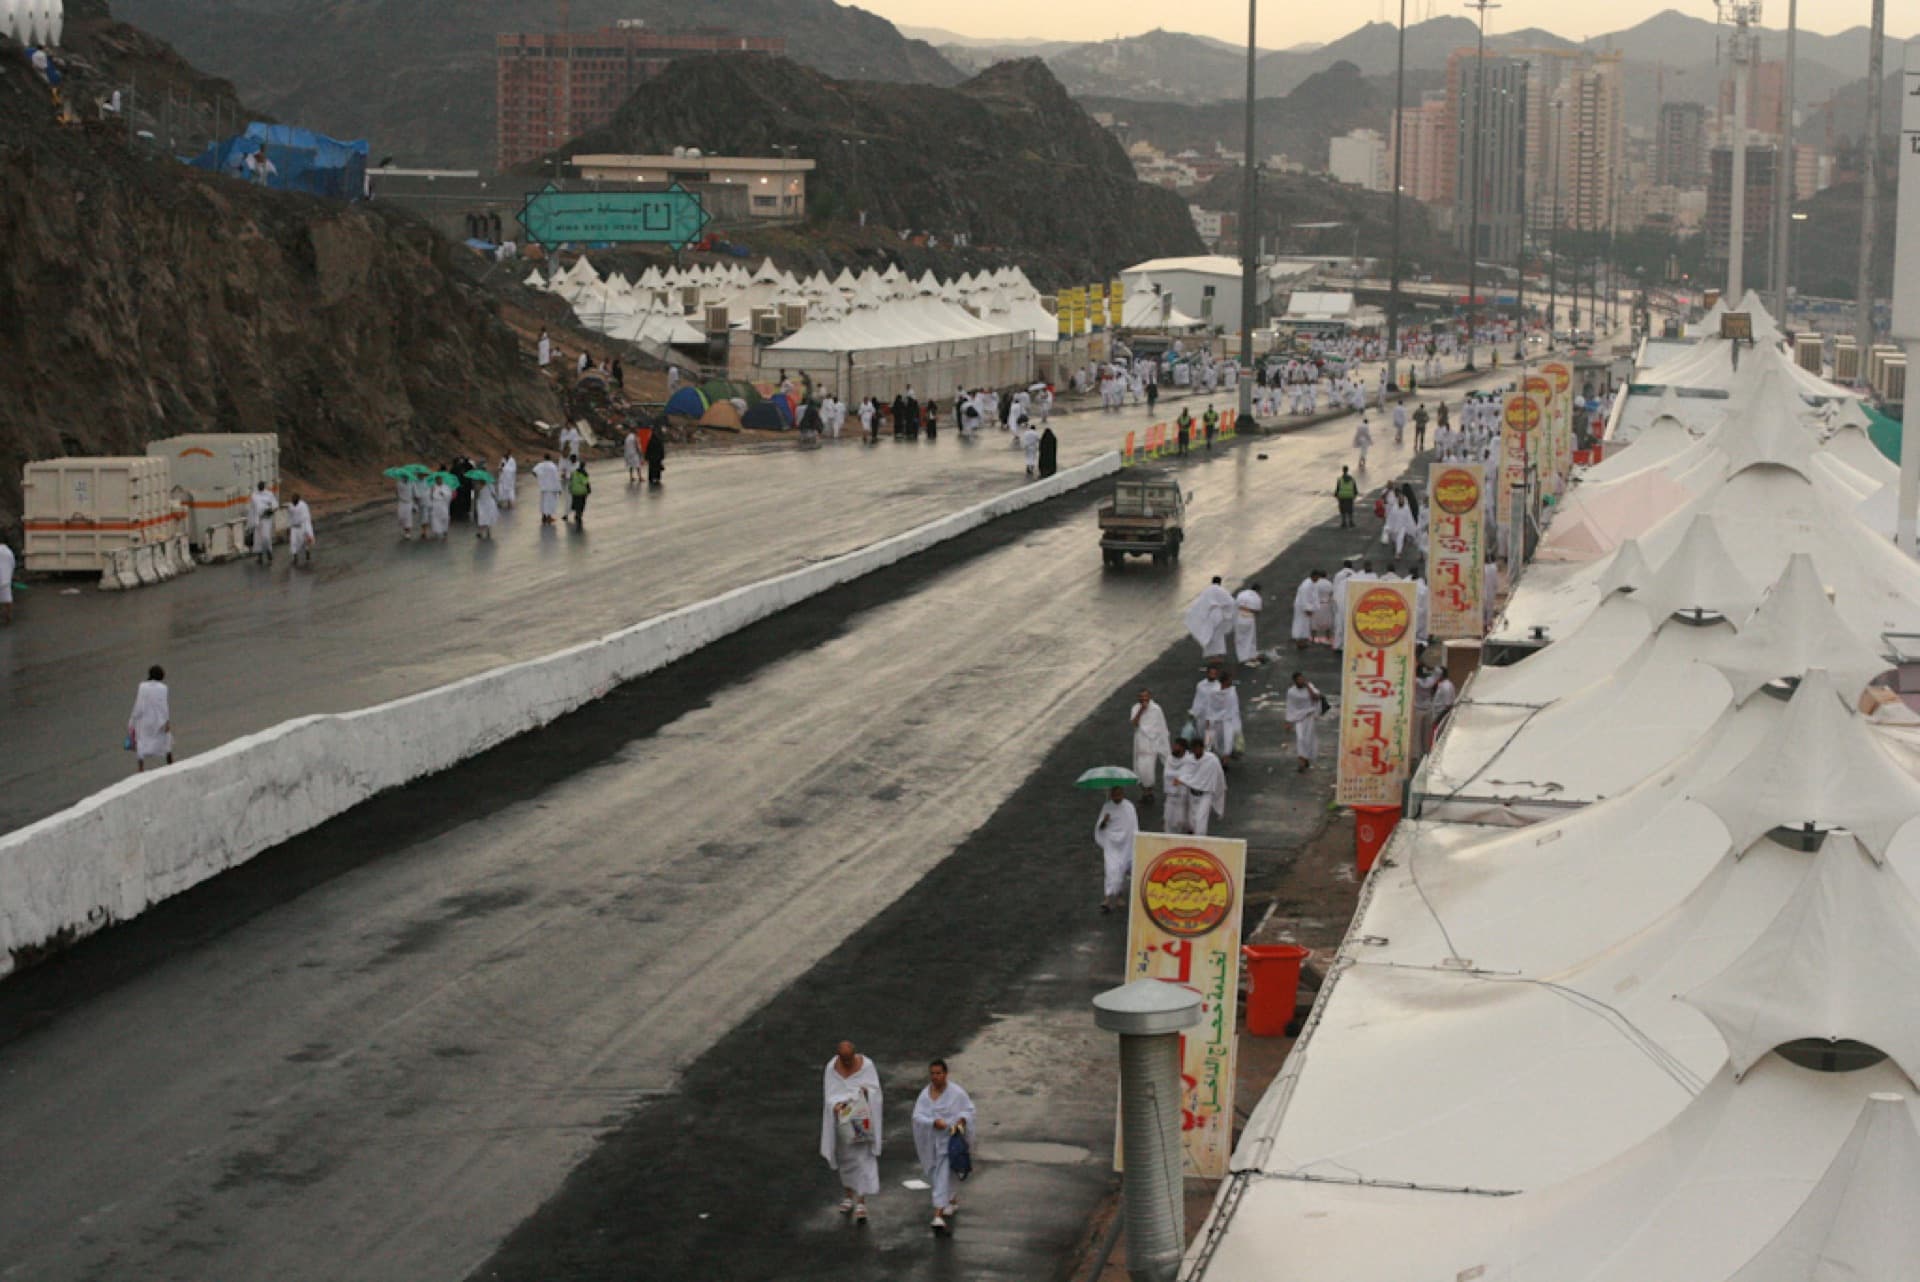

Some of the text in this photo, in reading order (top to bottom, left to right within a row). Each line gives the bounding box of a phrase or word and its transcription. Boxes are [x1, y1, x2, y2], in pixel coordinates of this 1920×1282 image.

[1355, 649, 1395, 699] غازي
[1350, 704, 1394, 775] القرشي
[1206, 950, 1227, 1000] لخدمة
[1206, 1003, 1227, 1055] حجاج
[1202, 1057, 1221, 1112] الداخل
